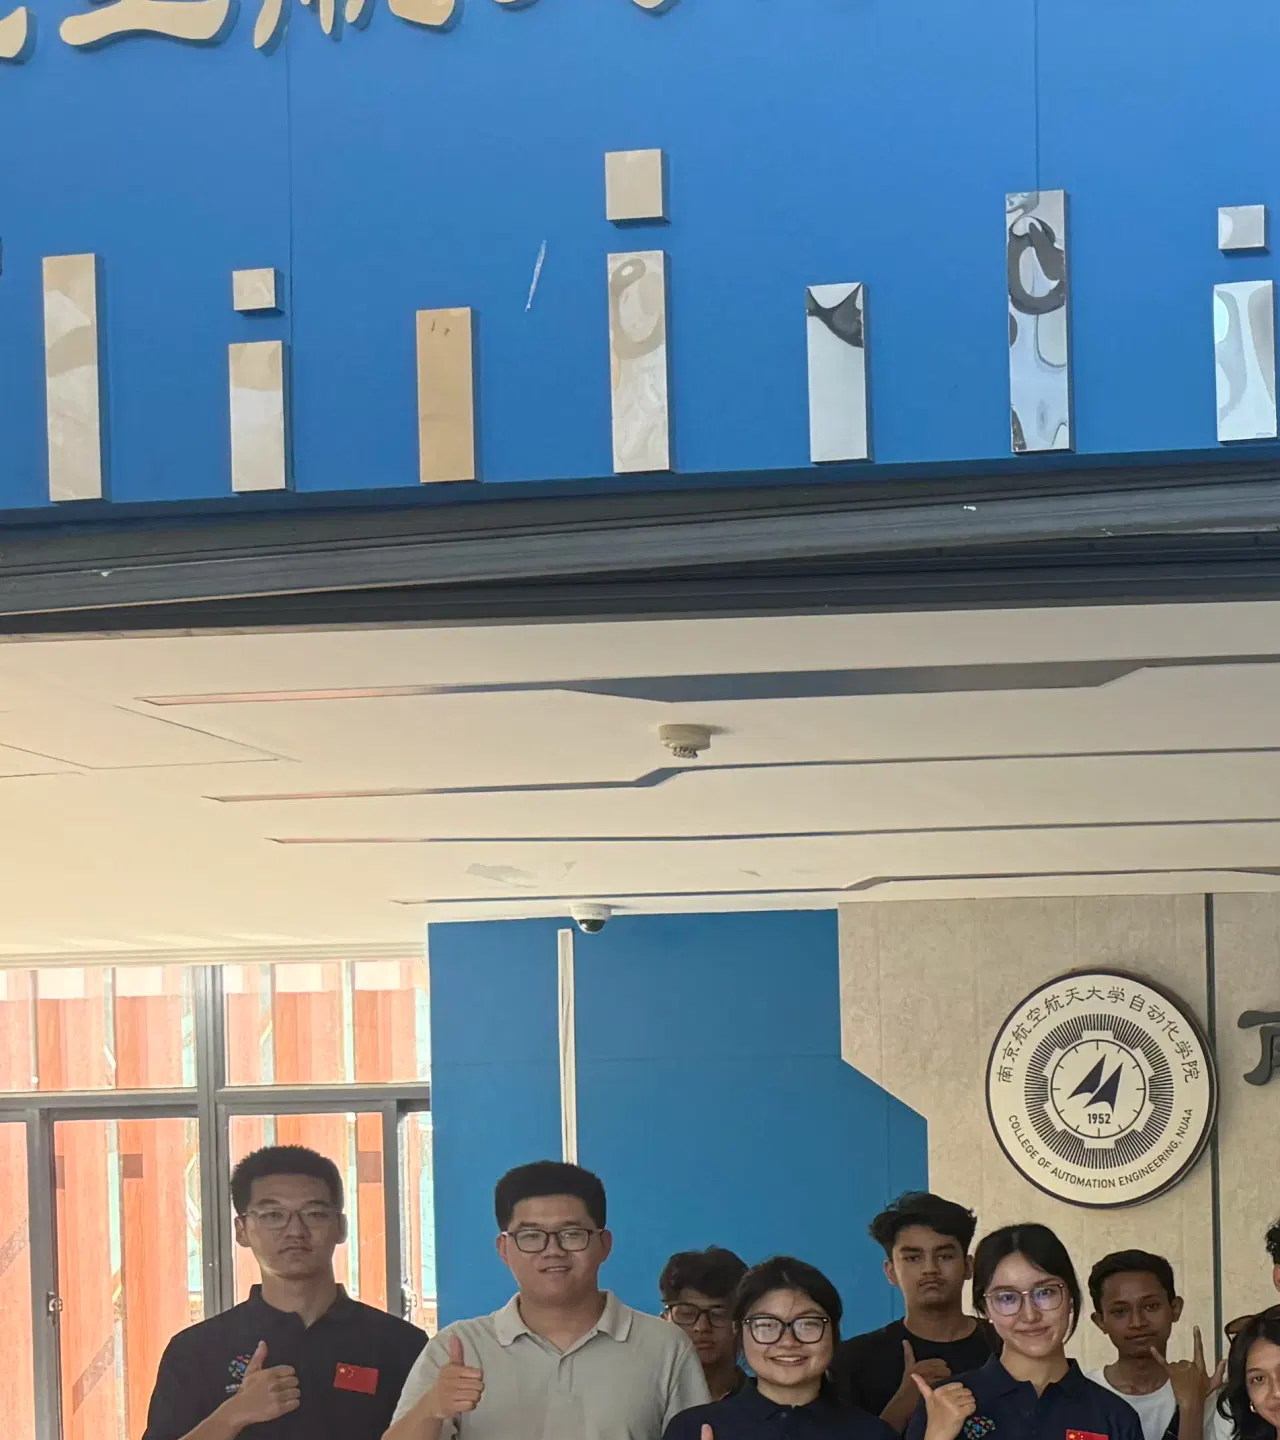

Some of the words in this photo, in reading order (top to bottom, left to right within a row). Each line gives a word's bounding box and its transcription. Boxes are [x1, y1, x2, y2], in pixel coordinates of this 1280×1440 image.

[997, 986, 1200, 1083] 南京航空航天大学自动化学院
[1008, 1114, 1039, 1160] COLLEGE
[1038, 1156, 1052, 1172] OF
[1051, 1166, 1116, 1189] AUTOMATION
[1119, 1140, 1182, 1187] ENGINEERING,
[1176, 1108, 1194, 1140] NUAA
[1087, 1113, 1111, 1125] 1952
